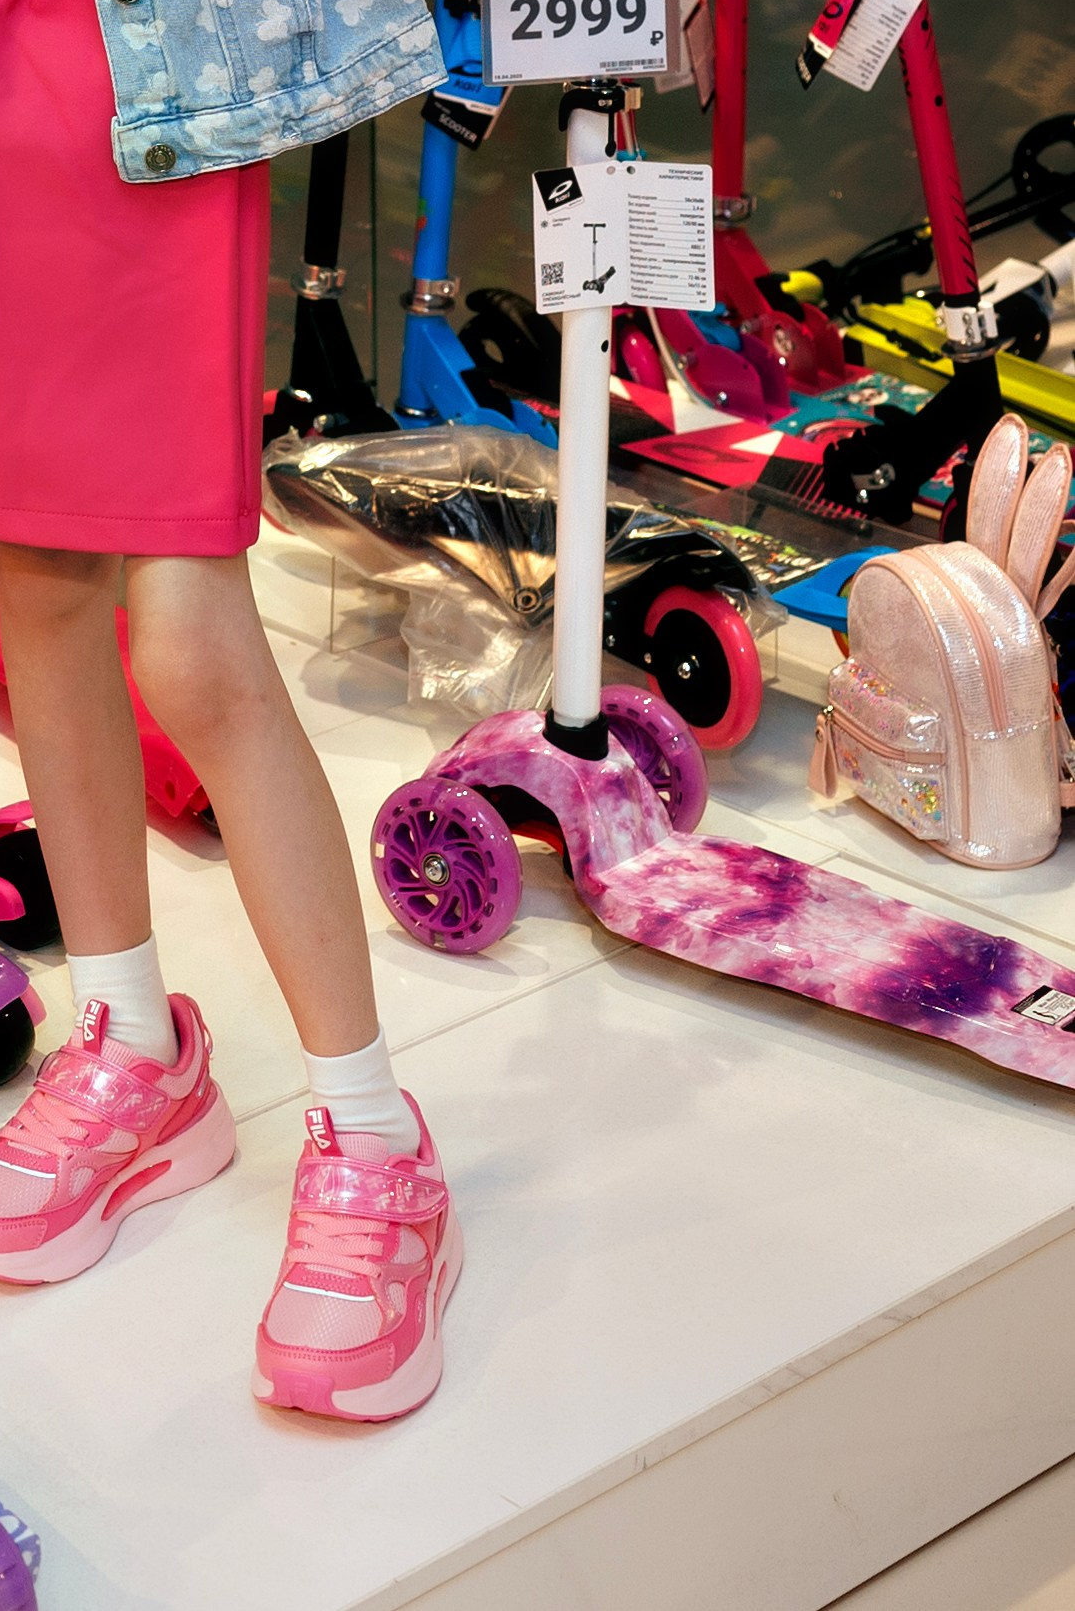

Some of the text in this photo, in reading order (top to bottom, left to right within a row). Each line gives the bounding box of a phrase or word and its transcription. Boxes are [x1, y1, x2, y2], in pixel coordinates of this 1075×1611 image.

[439, 113, 478, 143] SCOOTER
[83, 1000, 101, 1041] FILA
[307, 1110, 331, 1149] FILA
